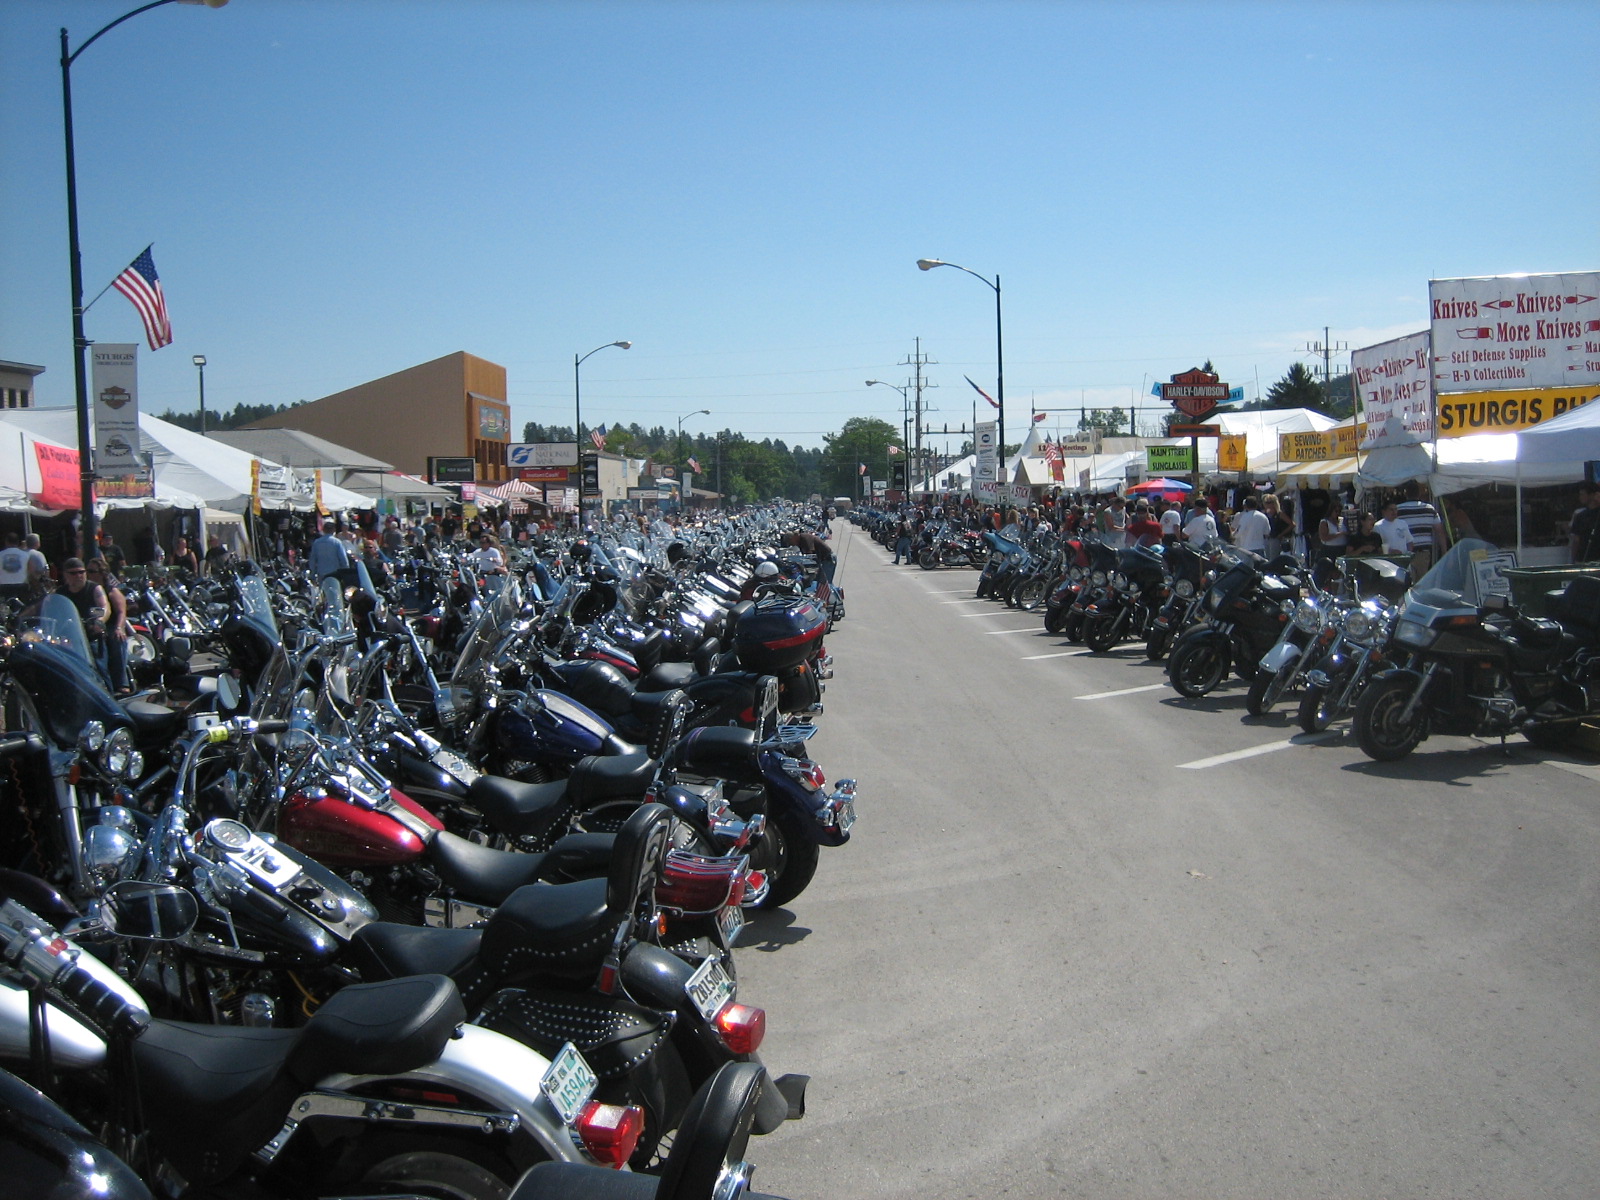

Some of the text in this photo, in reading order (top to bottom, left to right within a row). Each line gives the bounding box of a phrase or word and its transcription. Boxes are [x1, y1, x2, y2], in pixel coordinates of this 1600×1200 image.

[1433, 291, 1562, 320] Knives Knives
[1497, 318, 1581, 342] More Knives
[1451, 346, 1546, 364] Self Defense Supplies
[1453, 367, 1525, 382] H-D Collectibles
[1167, 386, 1225, 397] HARLEY-DAVIDSON
[1441, 398, 1542, 430] STURGIS
[1295, 433, 1321, 446] SEWING
[1150, 447, 1188, 457] MAIN STREET
[1296, 447, 1326, 459] PATCHES
[1152, 461, 1187, 470] SUNGLASSES
